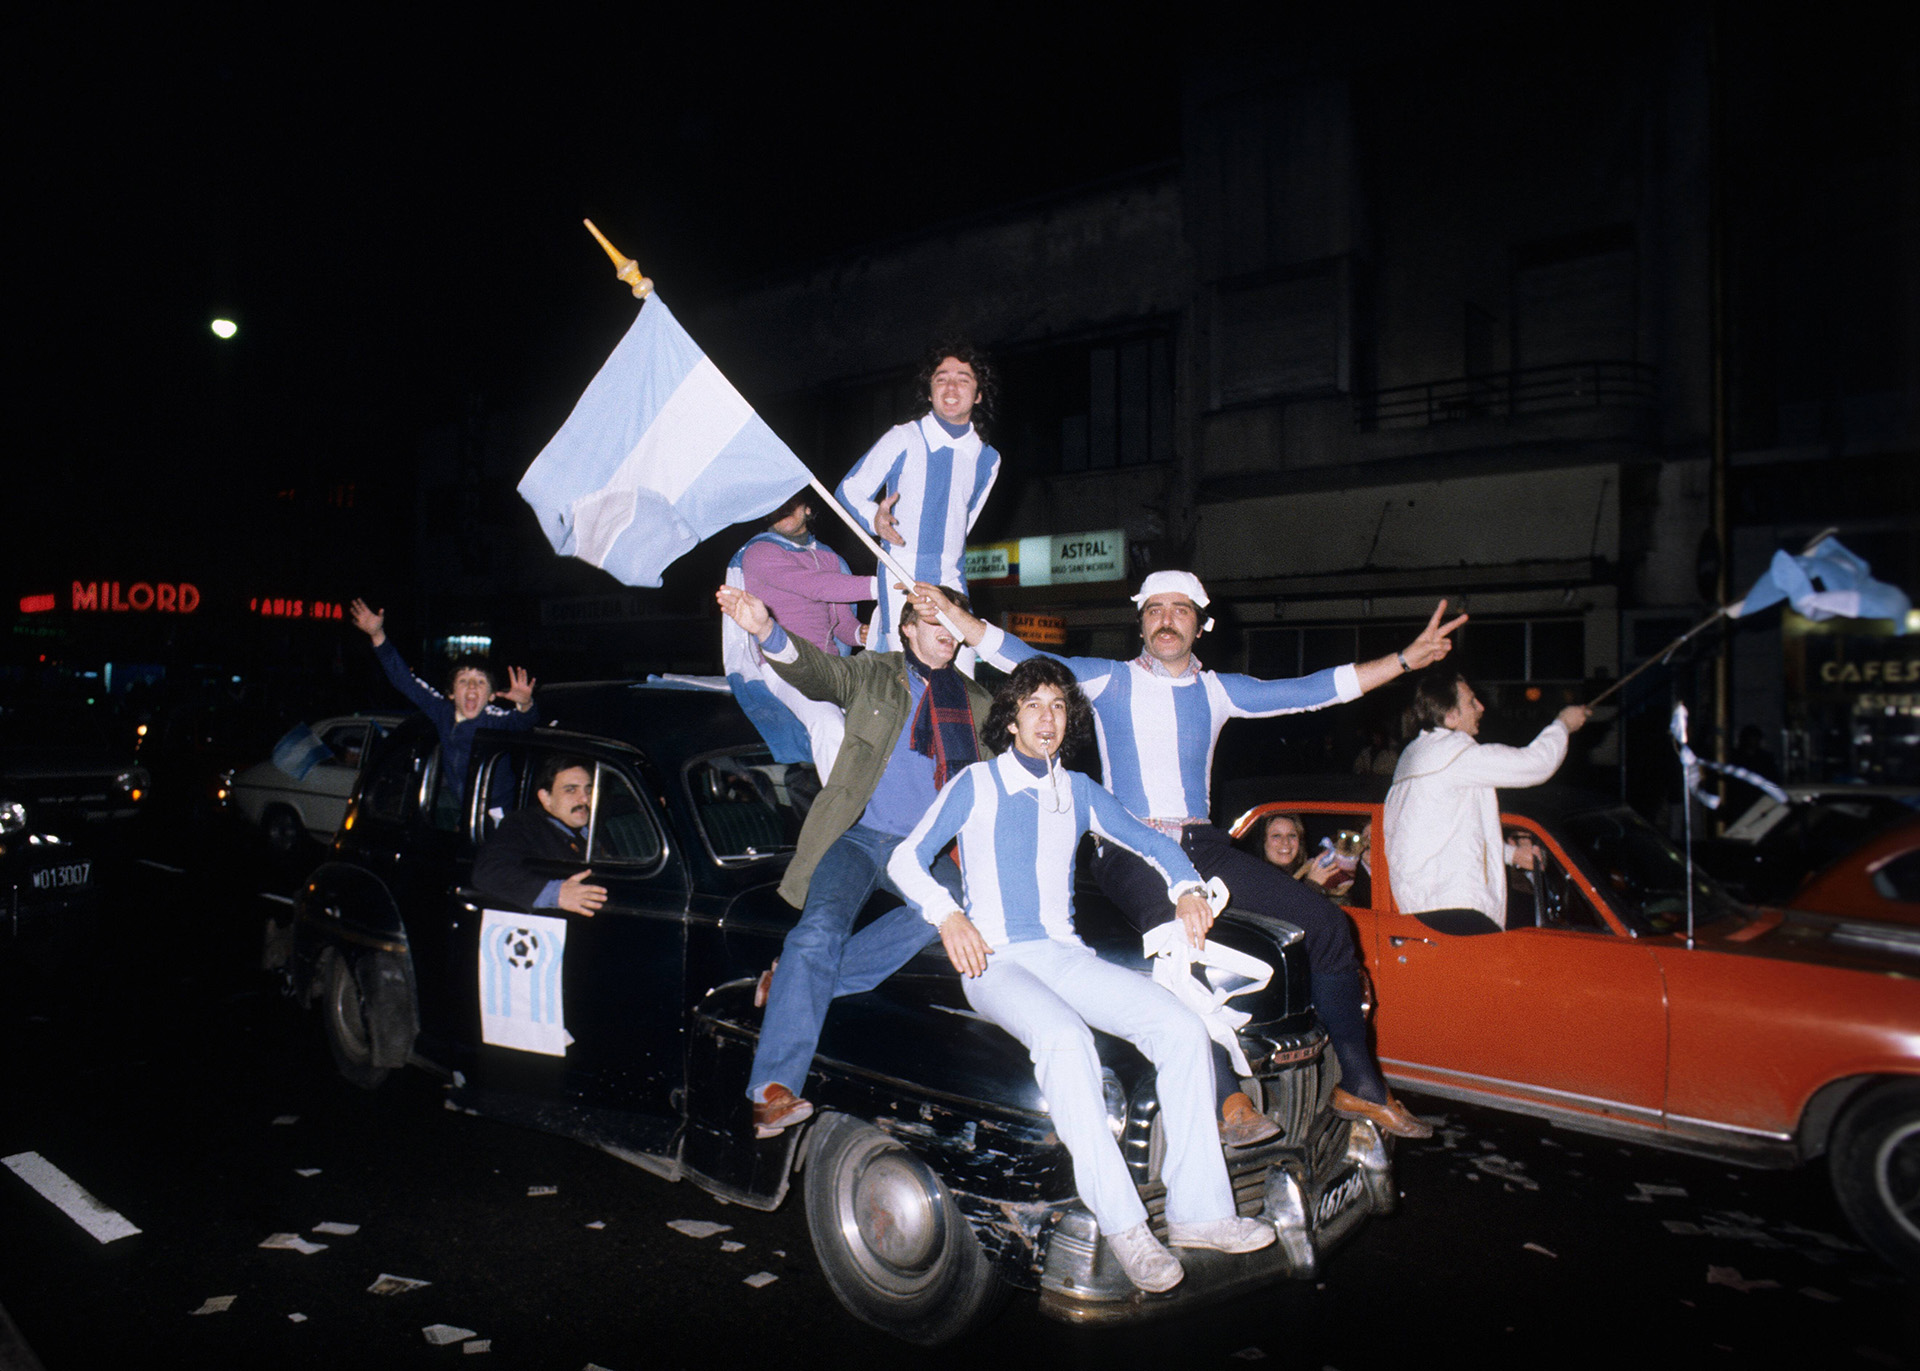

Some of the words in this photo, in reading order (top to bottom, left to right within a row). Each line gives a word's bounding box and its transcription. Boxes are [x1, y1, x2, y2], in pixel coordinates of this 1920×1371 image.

[1061, 540, 1107, 559] ASTRAL
[72, 580, 200, 613] MILORD
[1820, 661, 1920, 682] CAFES
